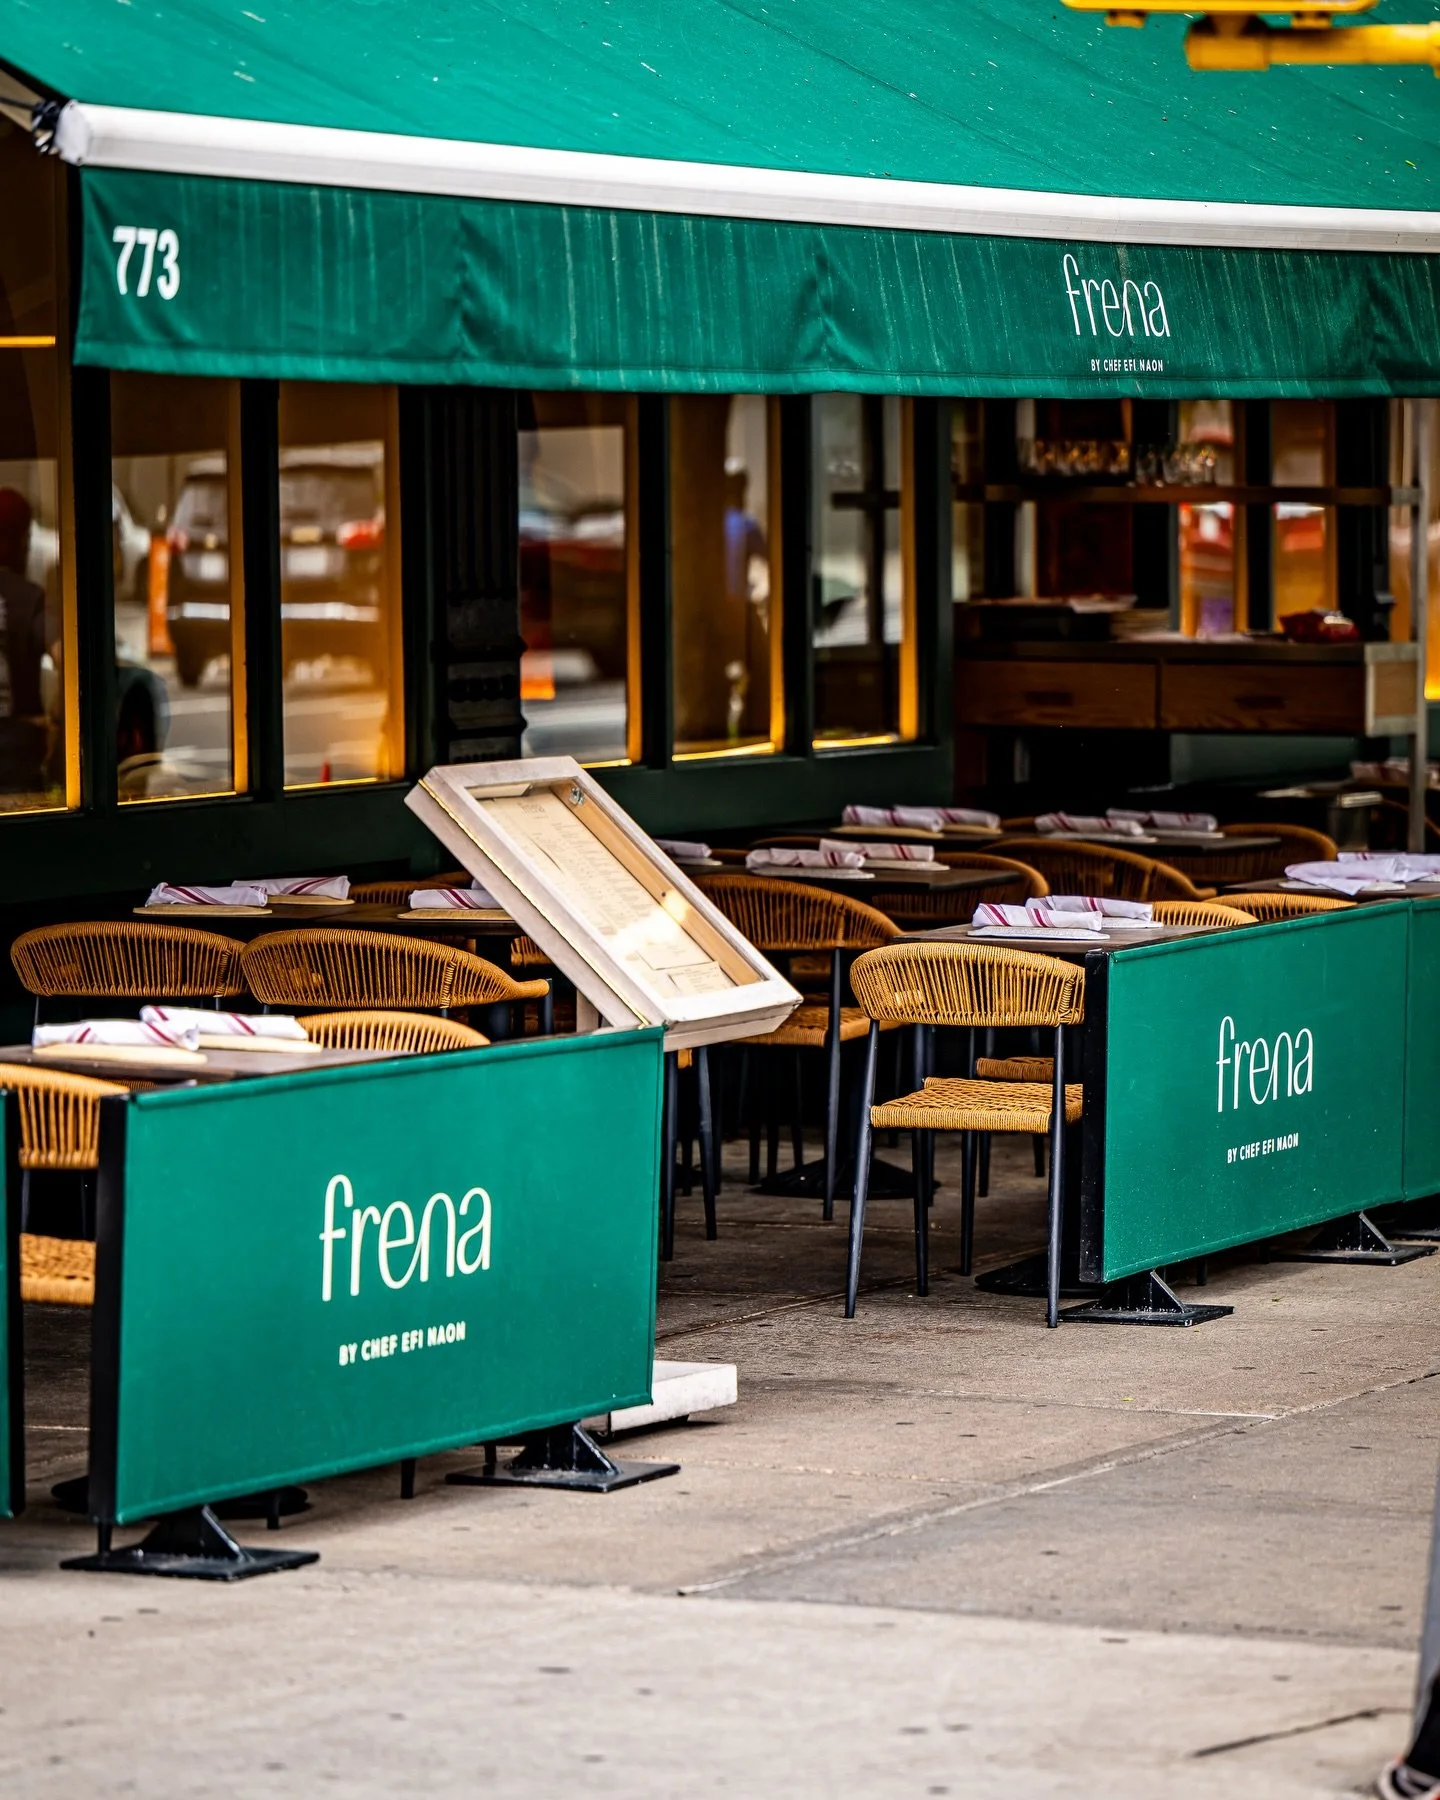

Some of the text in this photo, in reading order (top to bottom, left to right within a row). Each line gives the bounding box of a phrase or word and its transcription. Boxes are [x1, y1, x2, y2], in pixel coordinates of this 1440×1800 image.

[113, 225, 181, 301] 773
[1063, 253, 1171, 338] frena
[1090, 358, 1164, 372] BY CHEF EFI NAON
[1215, 1015, 1314, 1113] frena
[1227, 1132, 1299, 1164] BY CHEF EFI NAON
[319, 1174, 492, 1302] frena
[338, 1320, 466, 1366] BY CHEF EFI NAON
